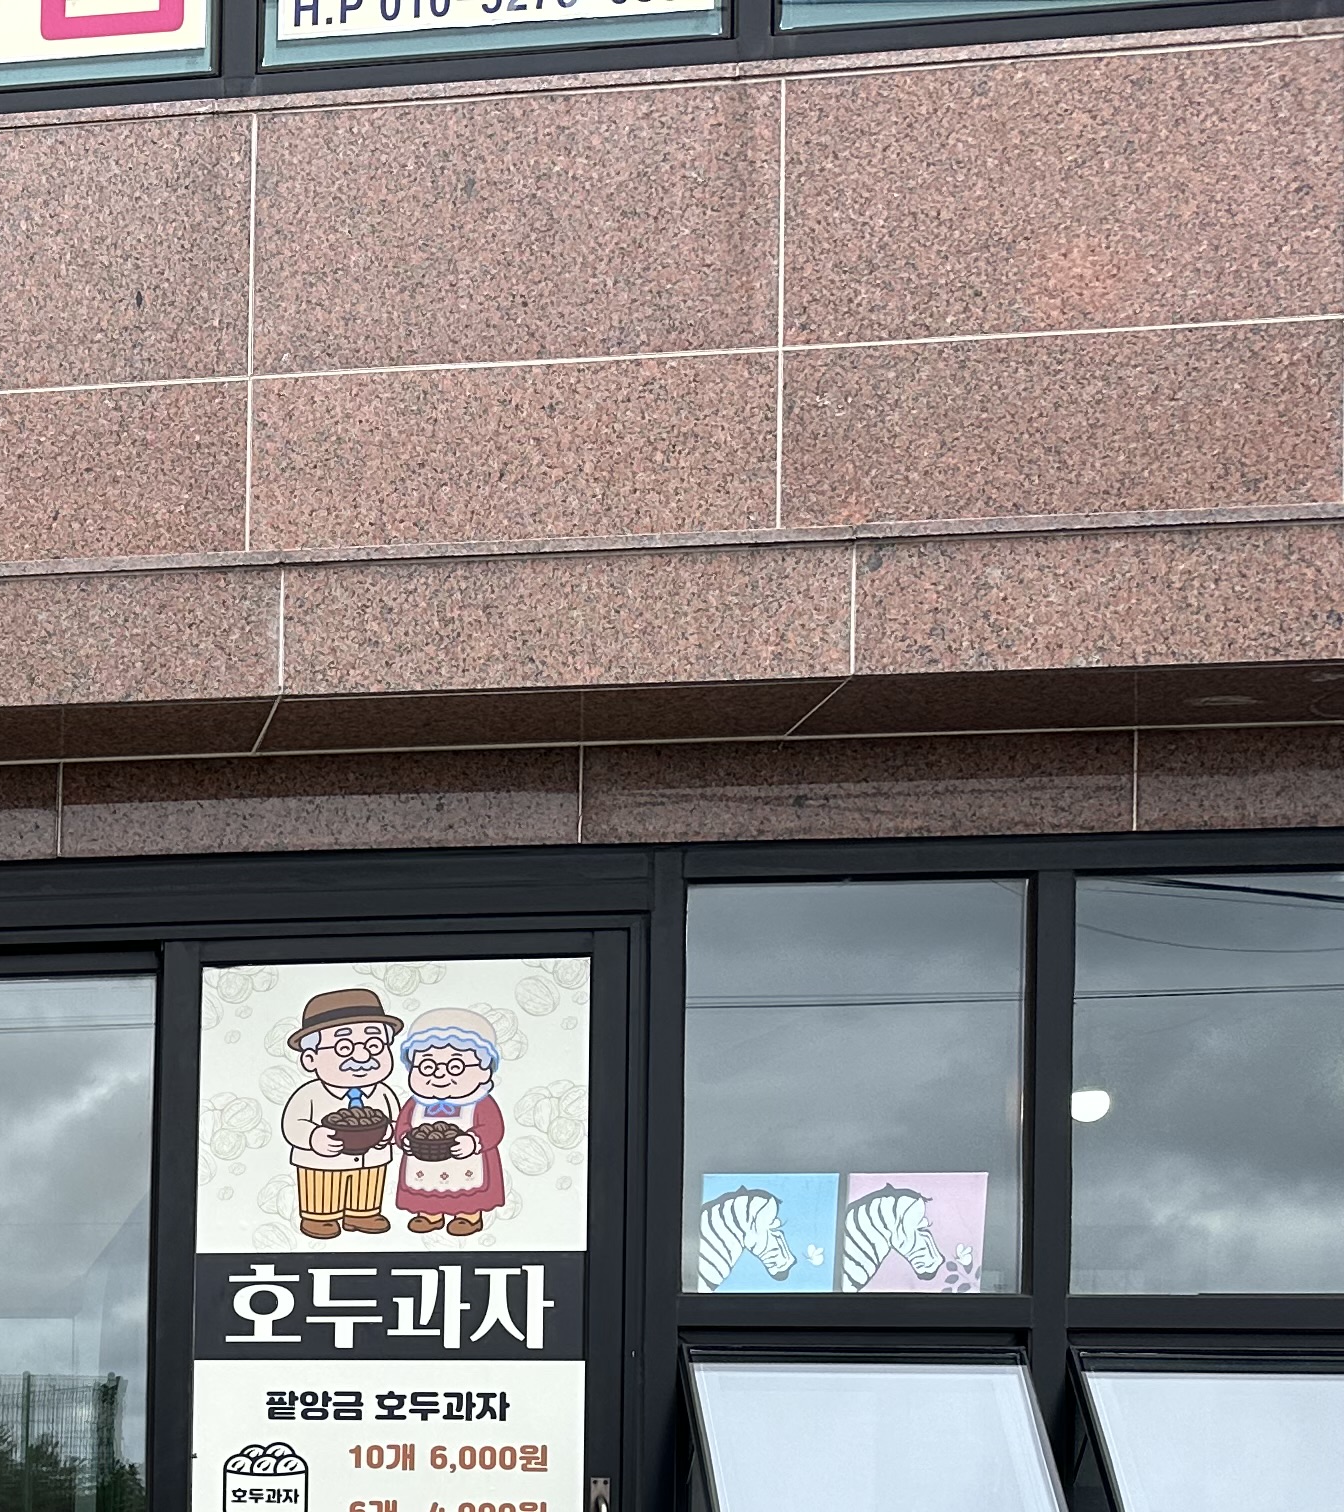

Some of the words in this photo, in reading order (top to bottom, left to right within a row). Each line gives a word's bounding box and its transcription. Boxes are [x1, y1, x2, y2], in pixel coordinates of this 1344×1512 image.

[225, 1264, 555, 1349] 호두과자
[265, 1390, 364, 1421] 팥앙금
[374, 1390, 511, 1422] 호두과자
[348, 1443, 416, 1472] 10개
[430, 1444, 549, 1474] 6,000원
[231, 1487, 300, 1505] 호두과자
